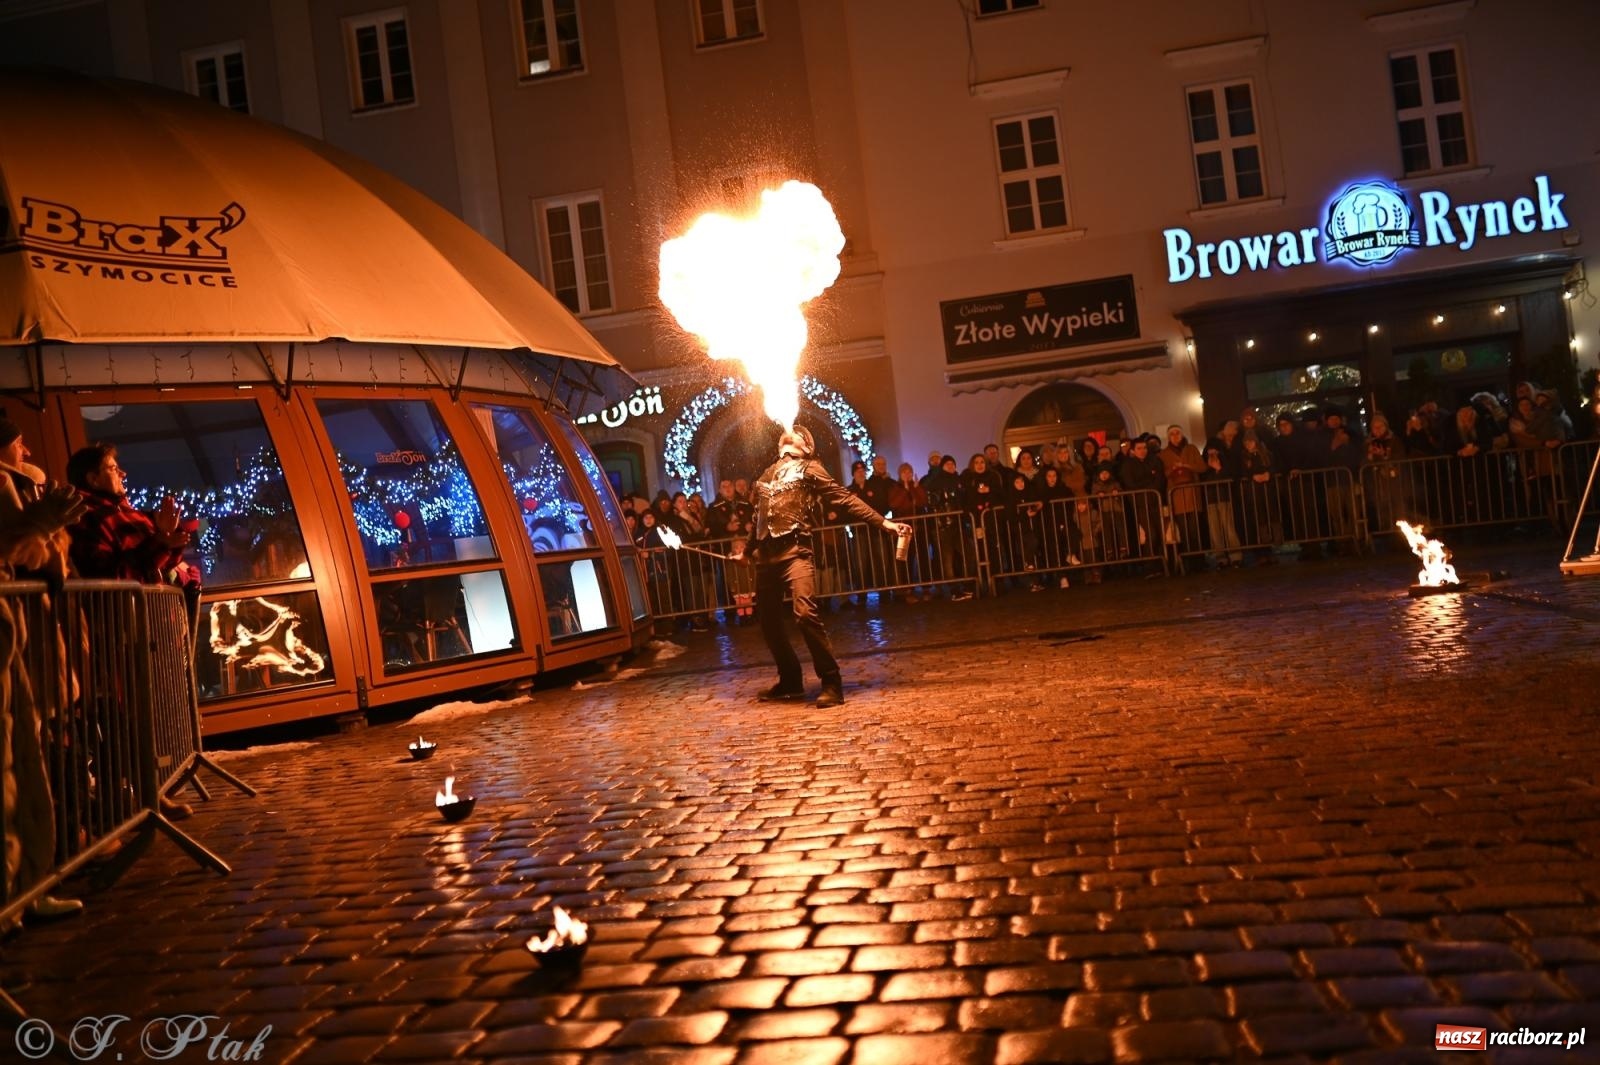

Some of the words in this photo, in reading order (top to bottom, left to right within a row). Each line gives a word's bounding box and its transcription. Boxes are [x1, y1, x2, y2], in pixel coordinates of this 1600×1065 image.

[1164, 228, 1319, 282] Browar
[1420, 176, 1568, 250] Rynek
[1336, 238, 1374, 254] Browar
[1376, 230, 1409, 248] Rynek
[31, 256, 238, 288] SZYMOCICE
[954, 320, 1016, 346] Złote
[1022, 302, 1125, 338] Wypieki
